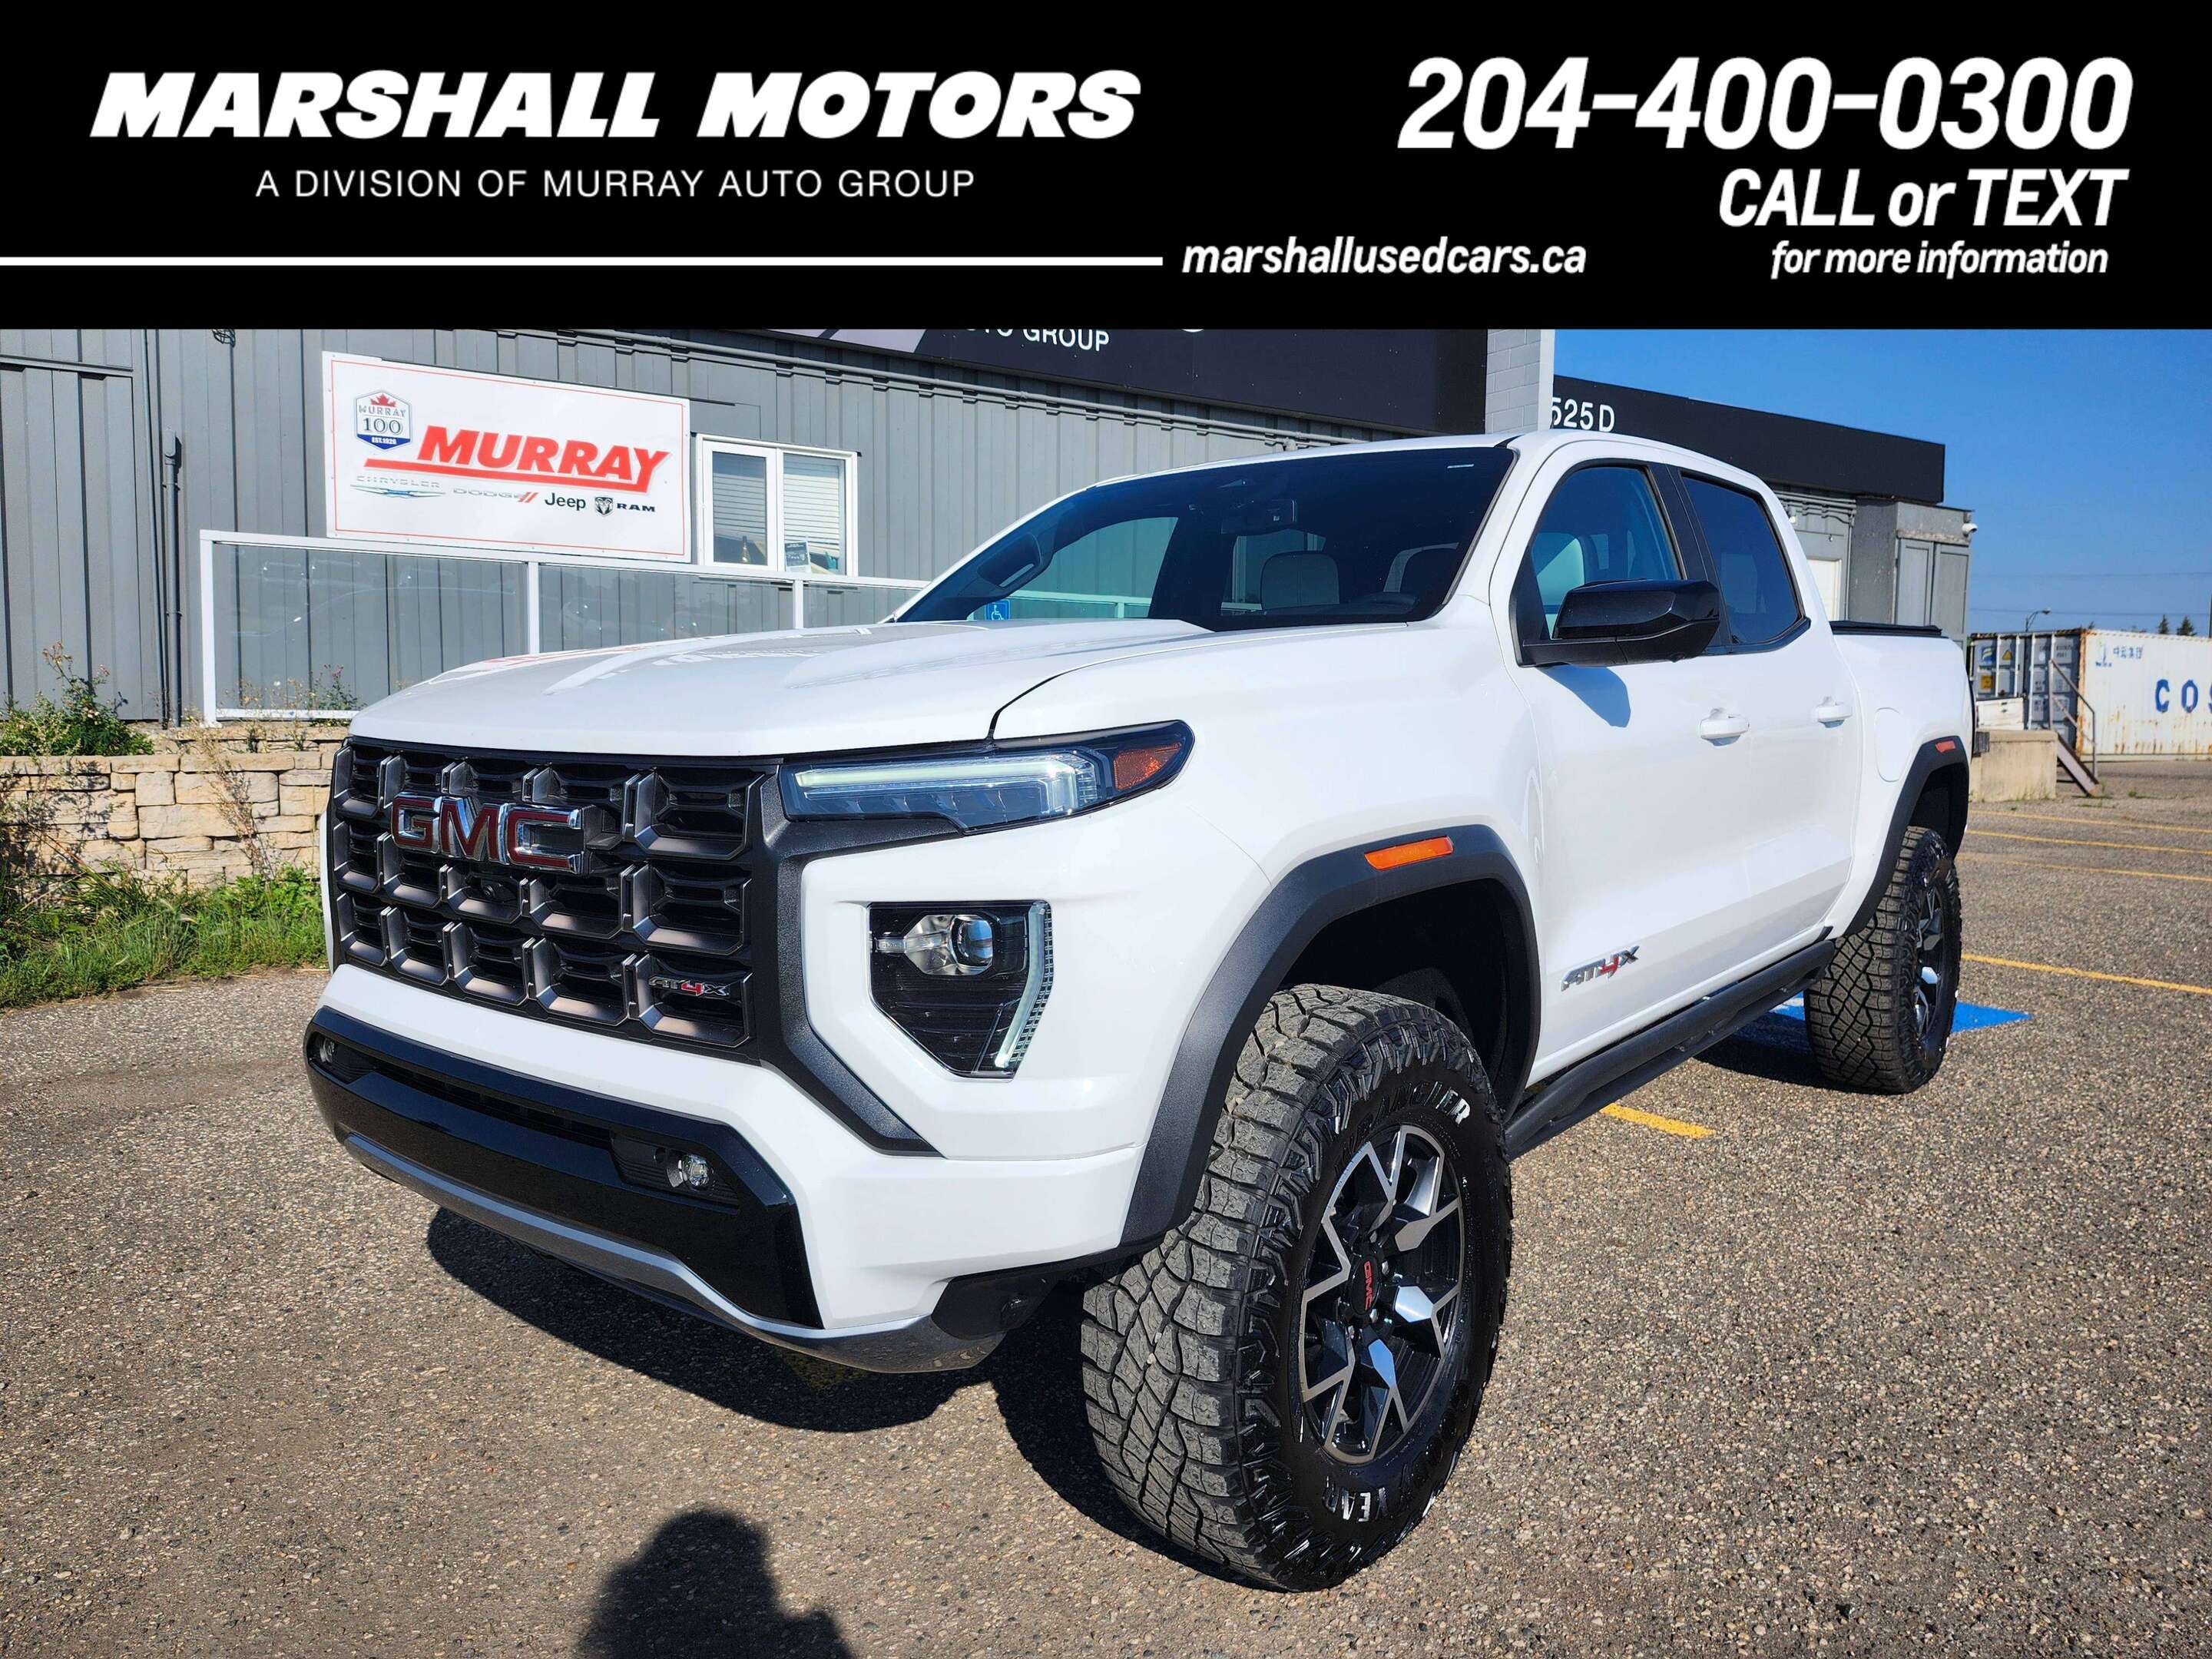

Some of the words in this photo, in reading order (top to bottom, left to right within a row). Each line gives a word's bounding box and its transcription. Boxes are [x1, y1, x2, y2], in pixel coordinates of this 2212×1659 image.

[359, 405, 406, 417] MURRAY
[363, 417, 403, 435] 100
[417, 425, 671, 493] MURRAY
[545, 492, 586, 511] Jeep
[616, 502, 655, 512] RAM
[2155, 679, 2212, 714] CO
[391, 790, 584, 876] GMC
